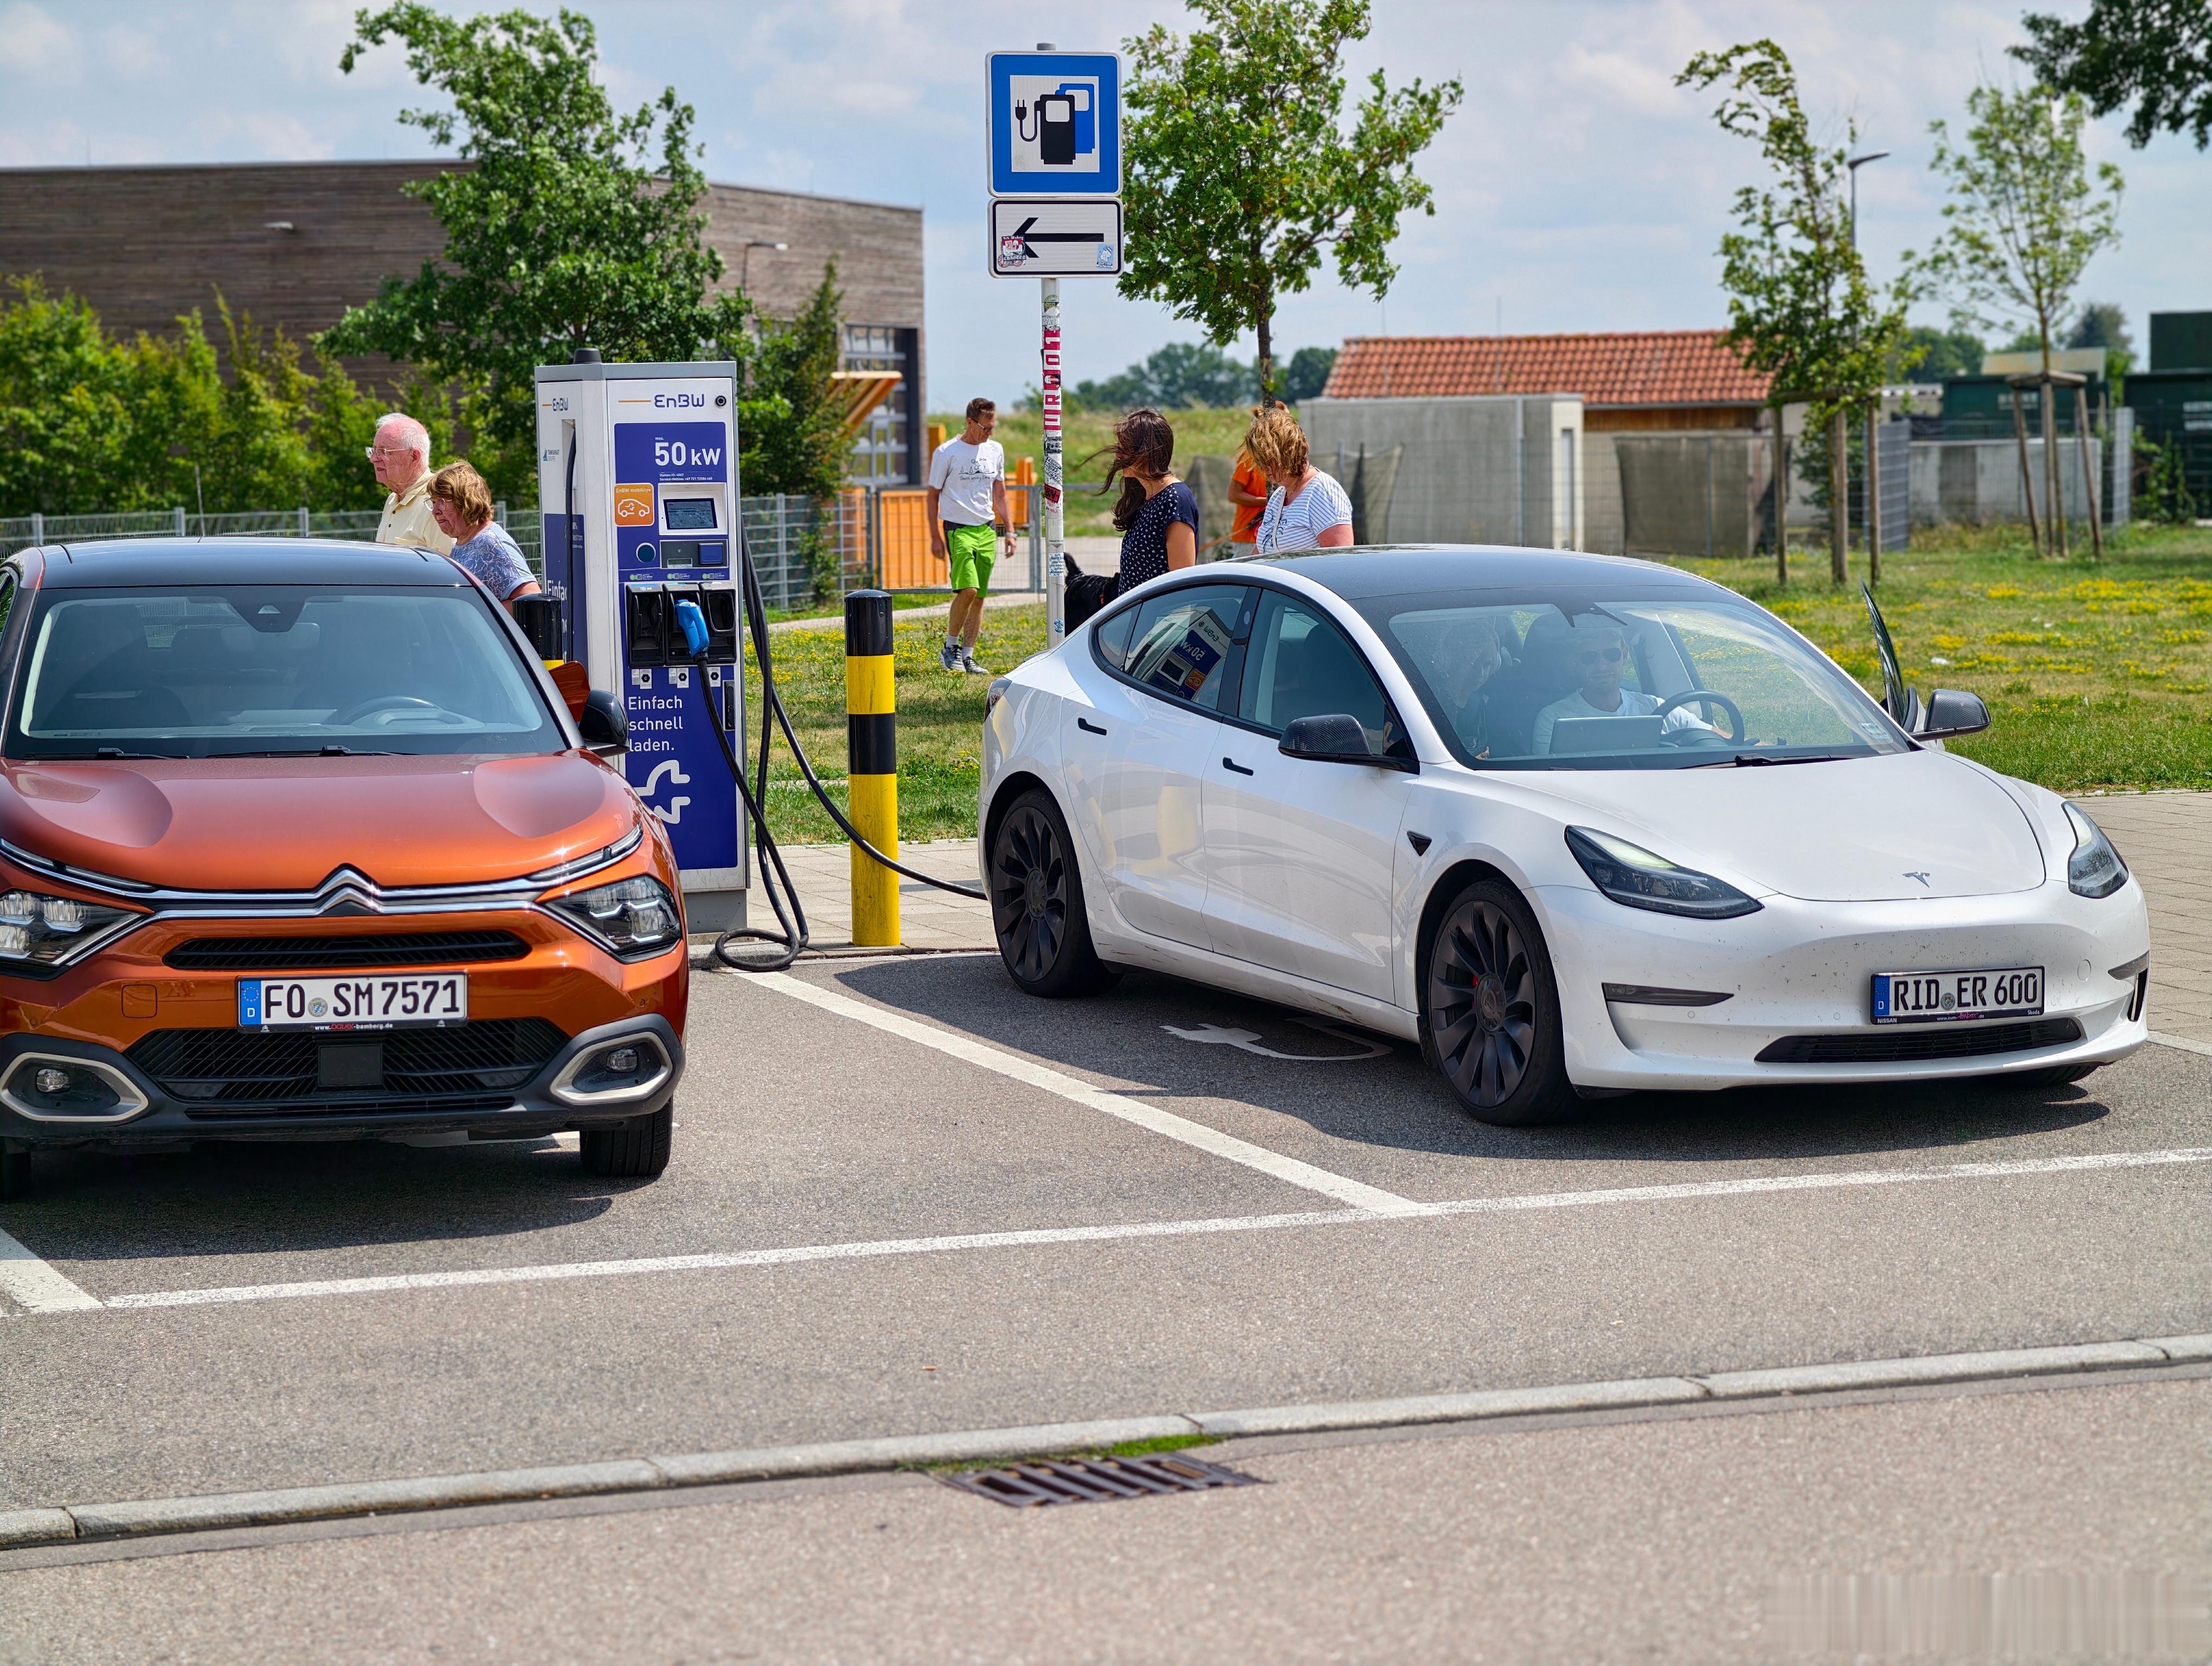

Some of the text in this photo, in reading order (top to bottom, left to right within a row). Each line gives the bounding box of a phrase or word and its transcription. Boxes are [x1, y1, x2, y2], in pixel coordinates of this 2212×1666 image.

[552, 397, 568, 411] EnBW
[654, 394, 705, 408] EnBW
[655, 441, 721, 466] 50 kW
[628, 695, 683, 710] Einfach
[629, 716, 683, 731] schnell
[629, 738, 674, 752] laden.
[247, 979, 459, 1018] D FO SM 7571
[1878, 973, 2037, 1011] D RID ER 600
